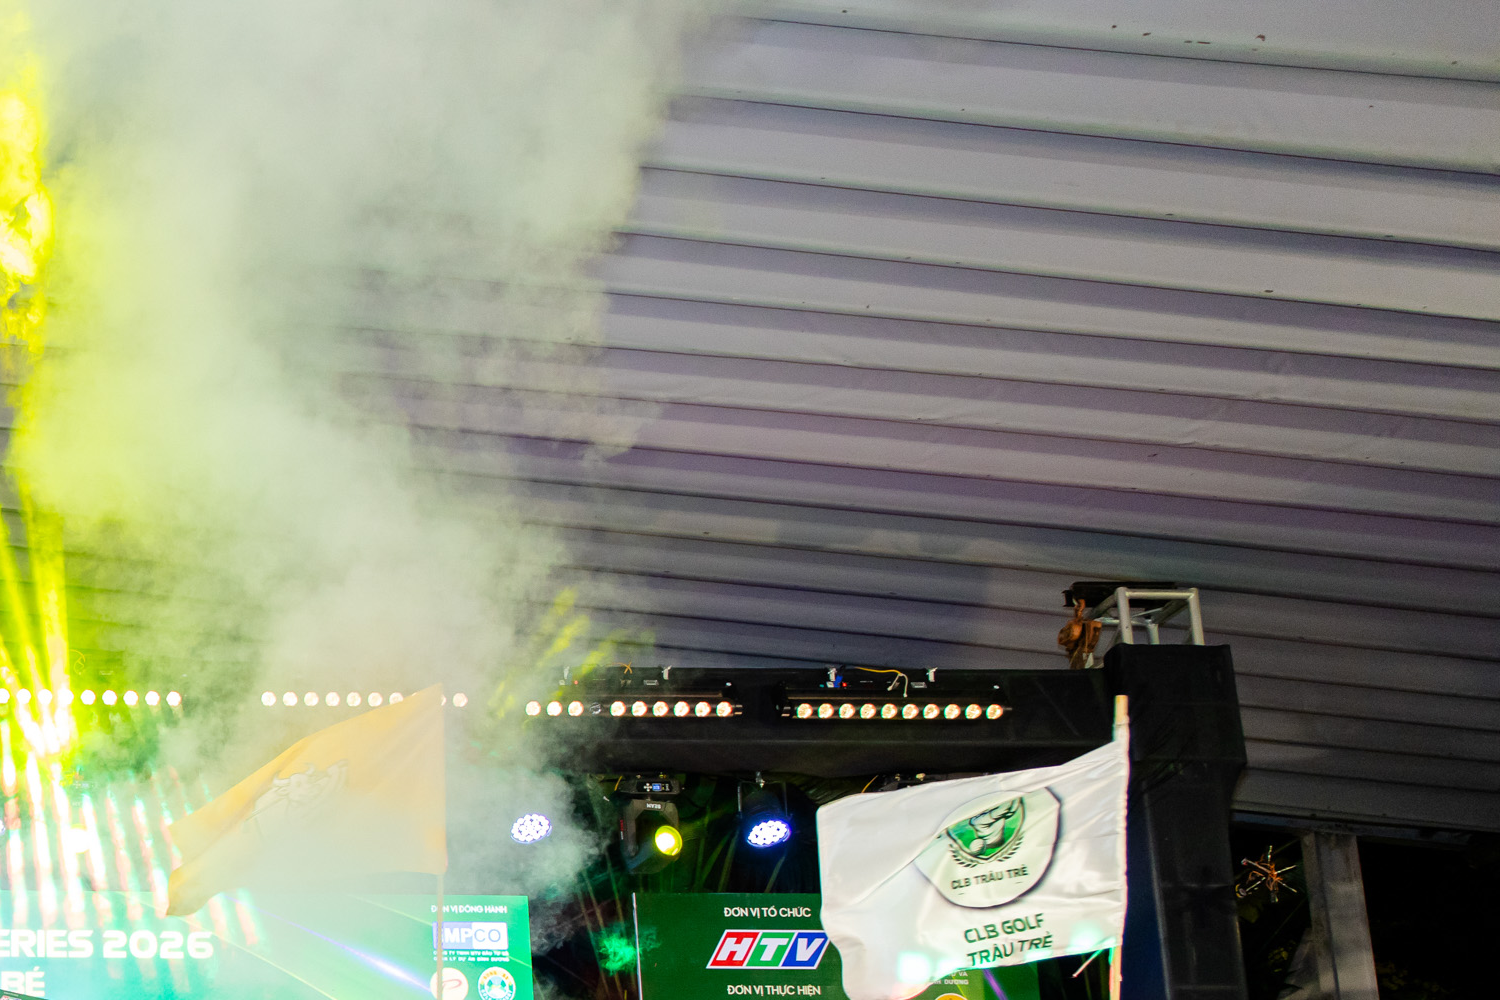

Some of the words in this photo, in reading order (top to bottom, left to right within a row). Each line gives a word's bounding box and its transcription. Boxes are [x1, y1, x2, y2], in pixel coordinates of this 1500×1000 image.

[951, 878, 971, 889] CLB
[973, 870, 1003, 885] TRÂU
[431, 904, 449, 913] ĐN
[723, 906, 749, 917] ĐƠN
[750, 907, 761, 918] VỊ
[761, 905, 777, 917] TỔ
[779, 906, 812, 917] CHỨC
[442, 928, 501, 943] MPCO
[964, 923, 1000, 944] CLB
[1001, 913, 1045, 935] GOLF
[102, 930, 214, 960] 2026
[712, 935, 827, 963] HTV
[967, 940, 1015, 966] TRÂU
[0, 966, 45, 997] BÉ
[727, 984, 752, 995] ĐƠN
[753, 985, 764, 996] VỊ
[765, 984, 795, 997] THỰC
[797, 984, 821, 997] HIỆN
